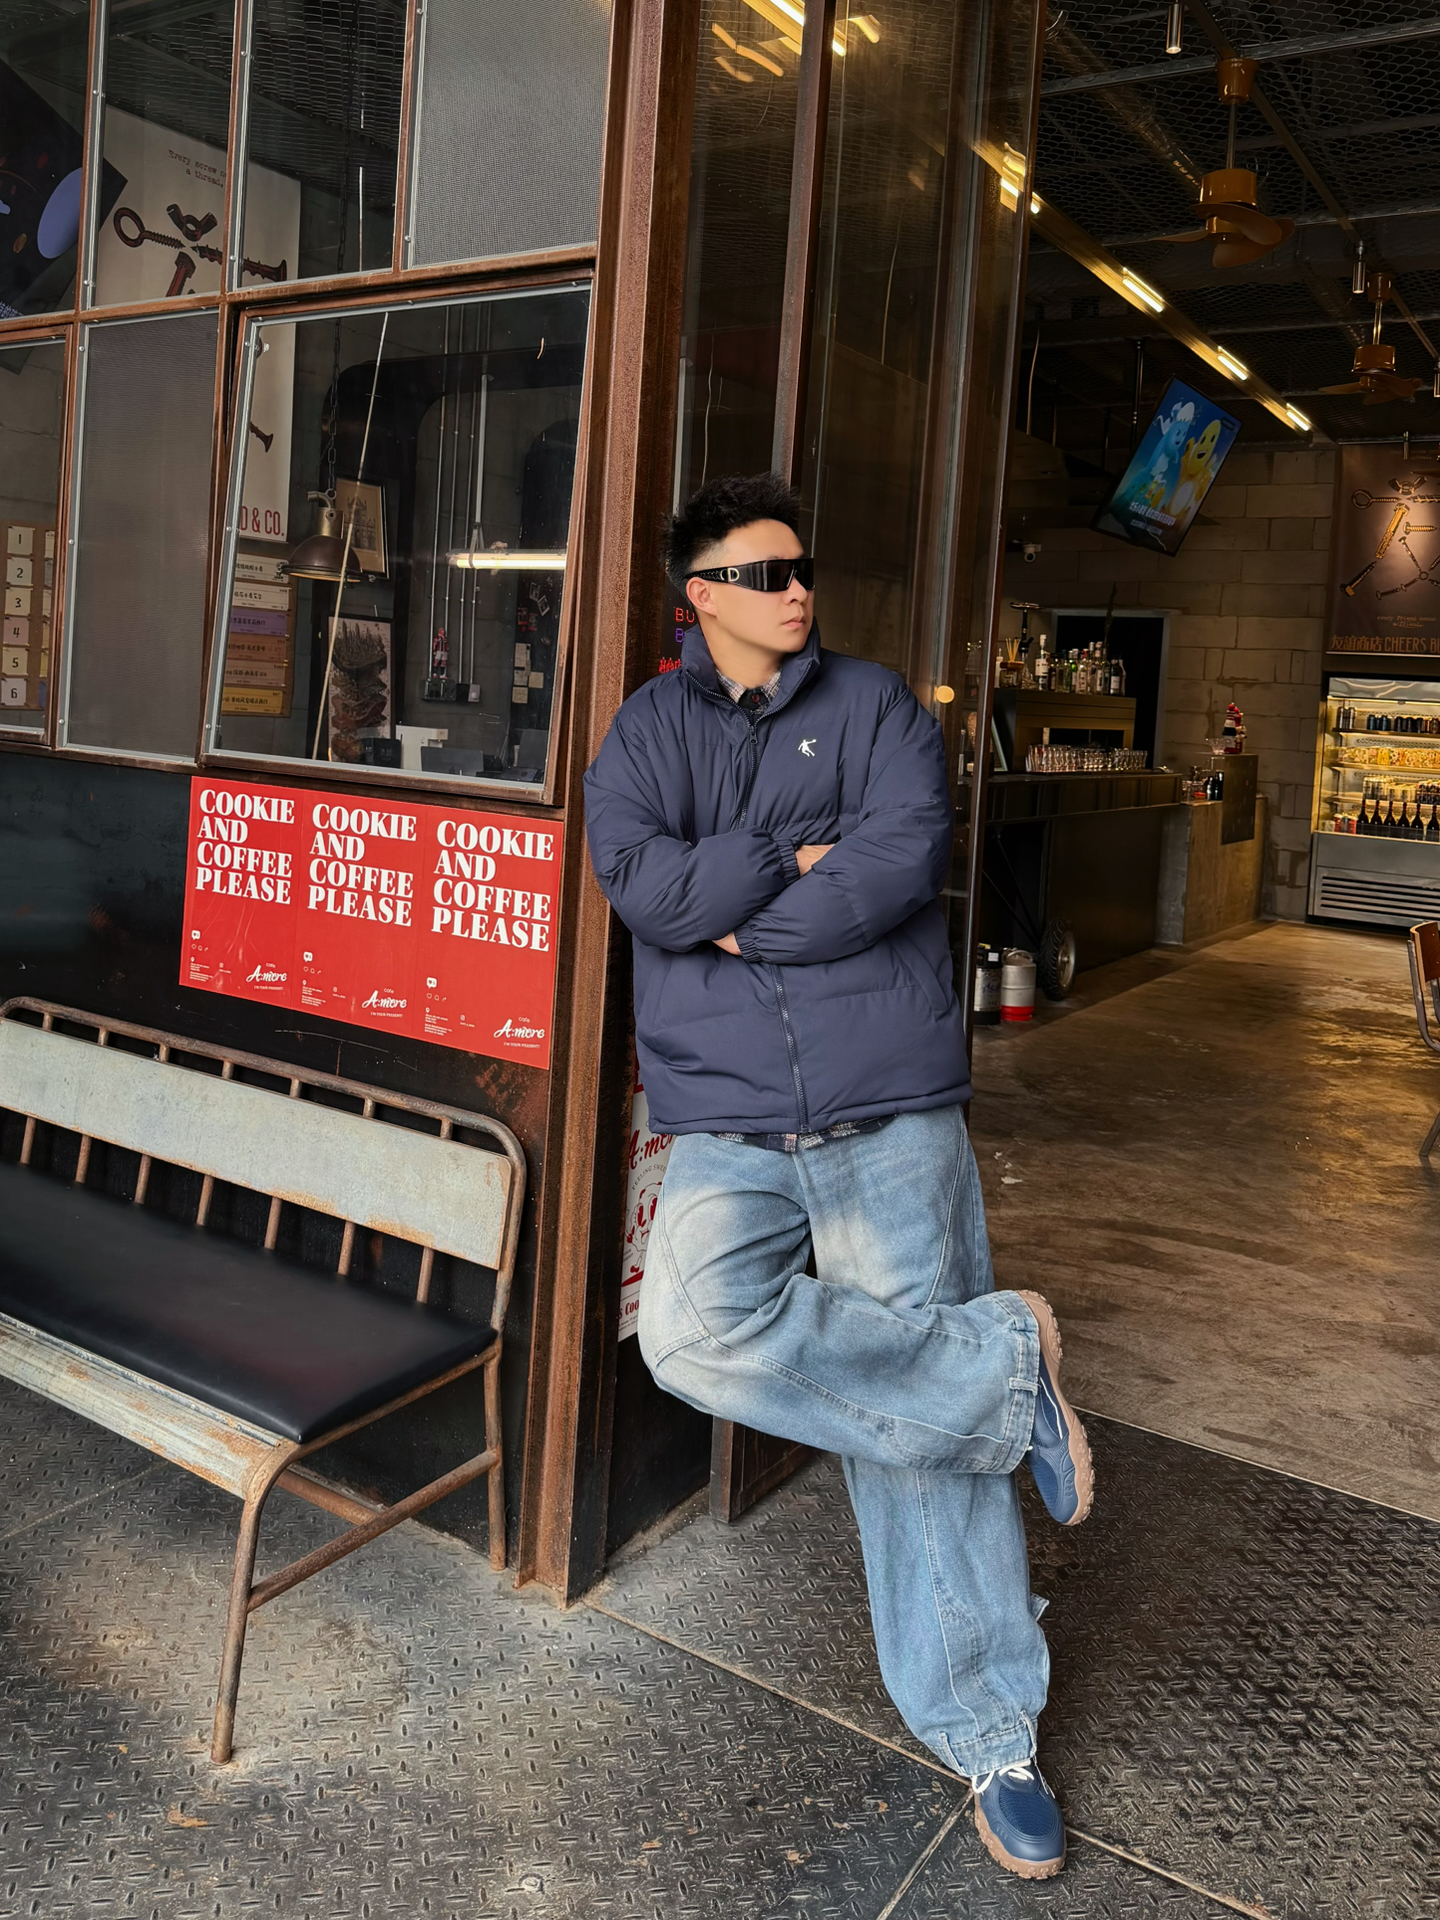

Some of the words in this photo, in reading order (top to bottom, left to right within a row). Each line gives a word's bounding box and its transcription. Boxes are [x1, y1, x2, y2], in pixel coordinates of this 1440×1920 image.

[168, 149, 191, 166] Every
[195, 161, 218, 174] screw
[264, 509, 285, 537] CO.
[18, 533, 22, 545] 1
[16, 567, 24, 579] 2
[15, 597, 22, 609] 3
[12, 627, 21, 639] 4
[1384, 636, 1427, 653] CHEERS
[11, 657, 19, 669] 5
[10, 687, 18, 700] 6
[199, 789, 295, 824] COOKIE
[196, 815, 249, 844] AND
[312, 803, 417, 842] COOKIE
[309, 830, 365, 861] AND
[436, 820, 554, 861] COOKIE
[197, 841, 292, 878] COFFEE
[433, 849, 496, 882] AND
[194, 866, 291, 905] PLEASE
[309, 858, 413, 899] COFFEE
[307, 884, 412, 927] PLEASE
[433, 878, 551, 922] COFFEE
[431, 906, 549, 952] PLEASE
